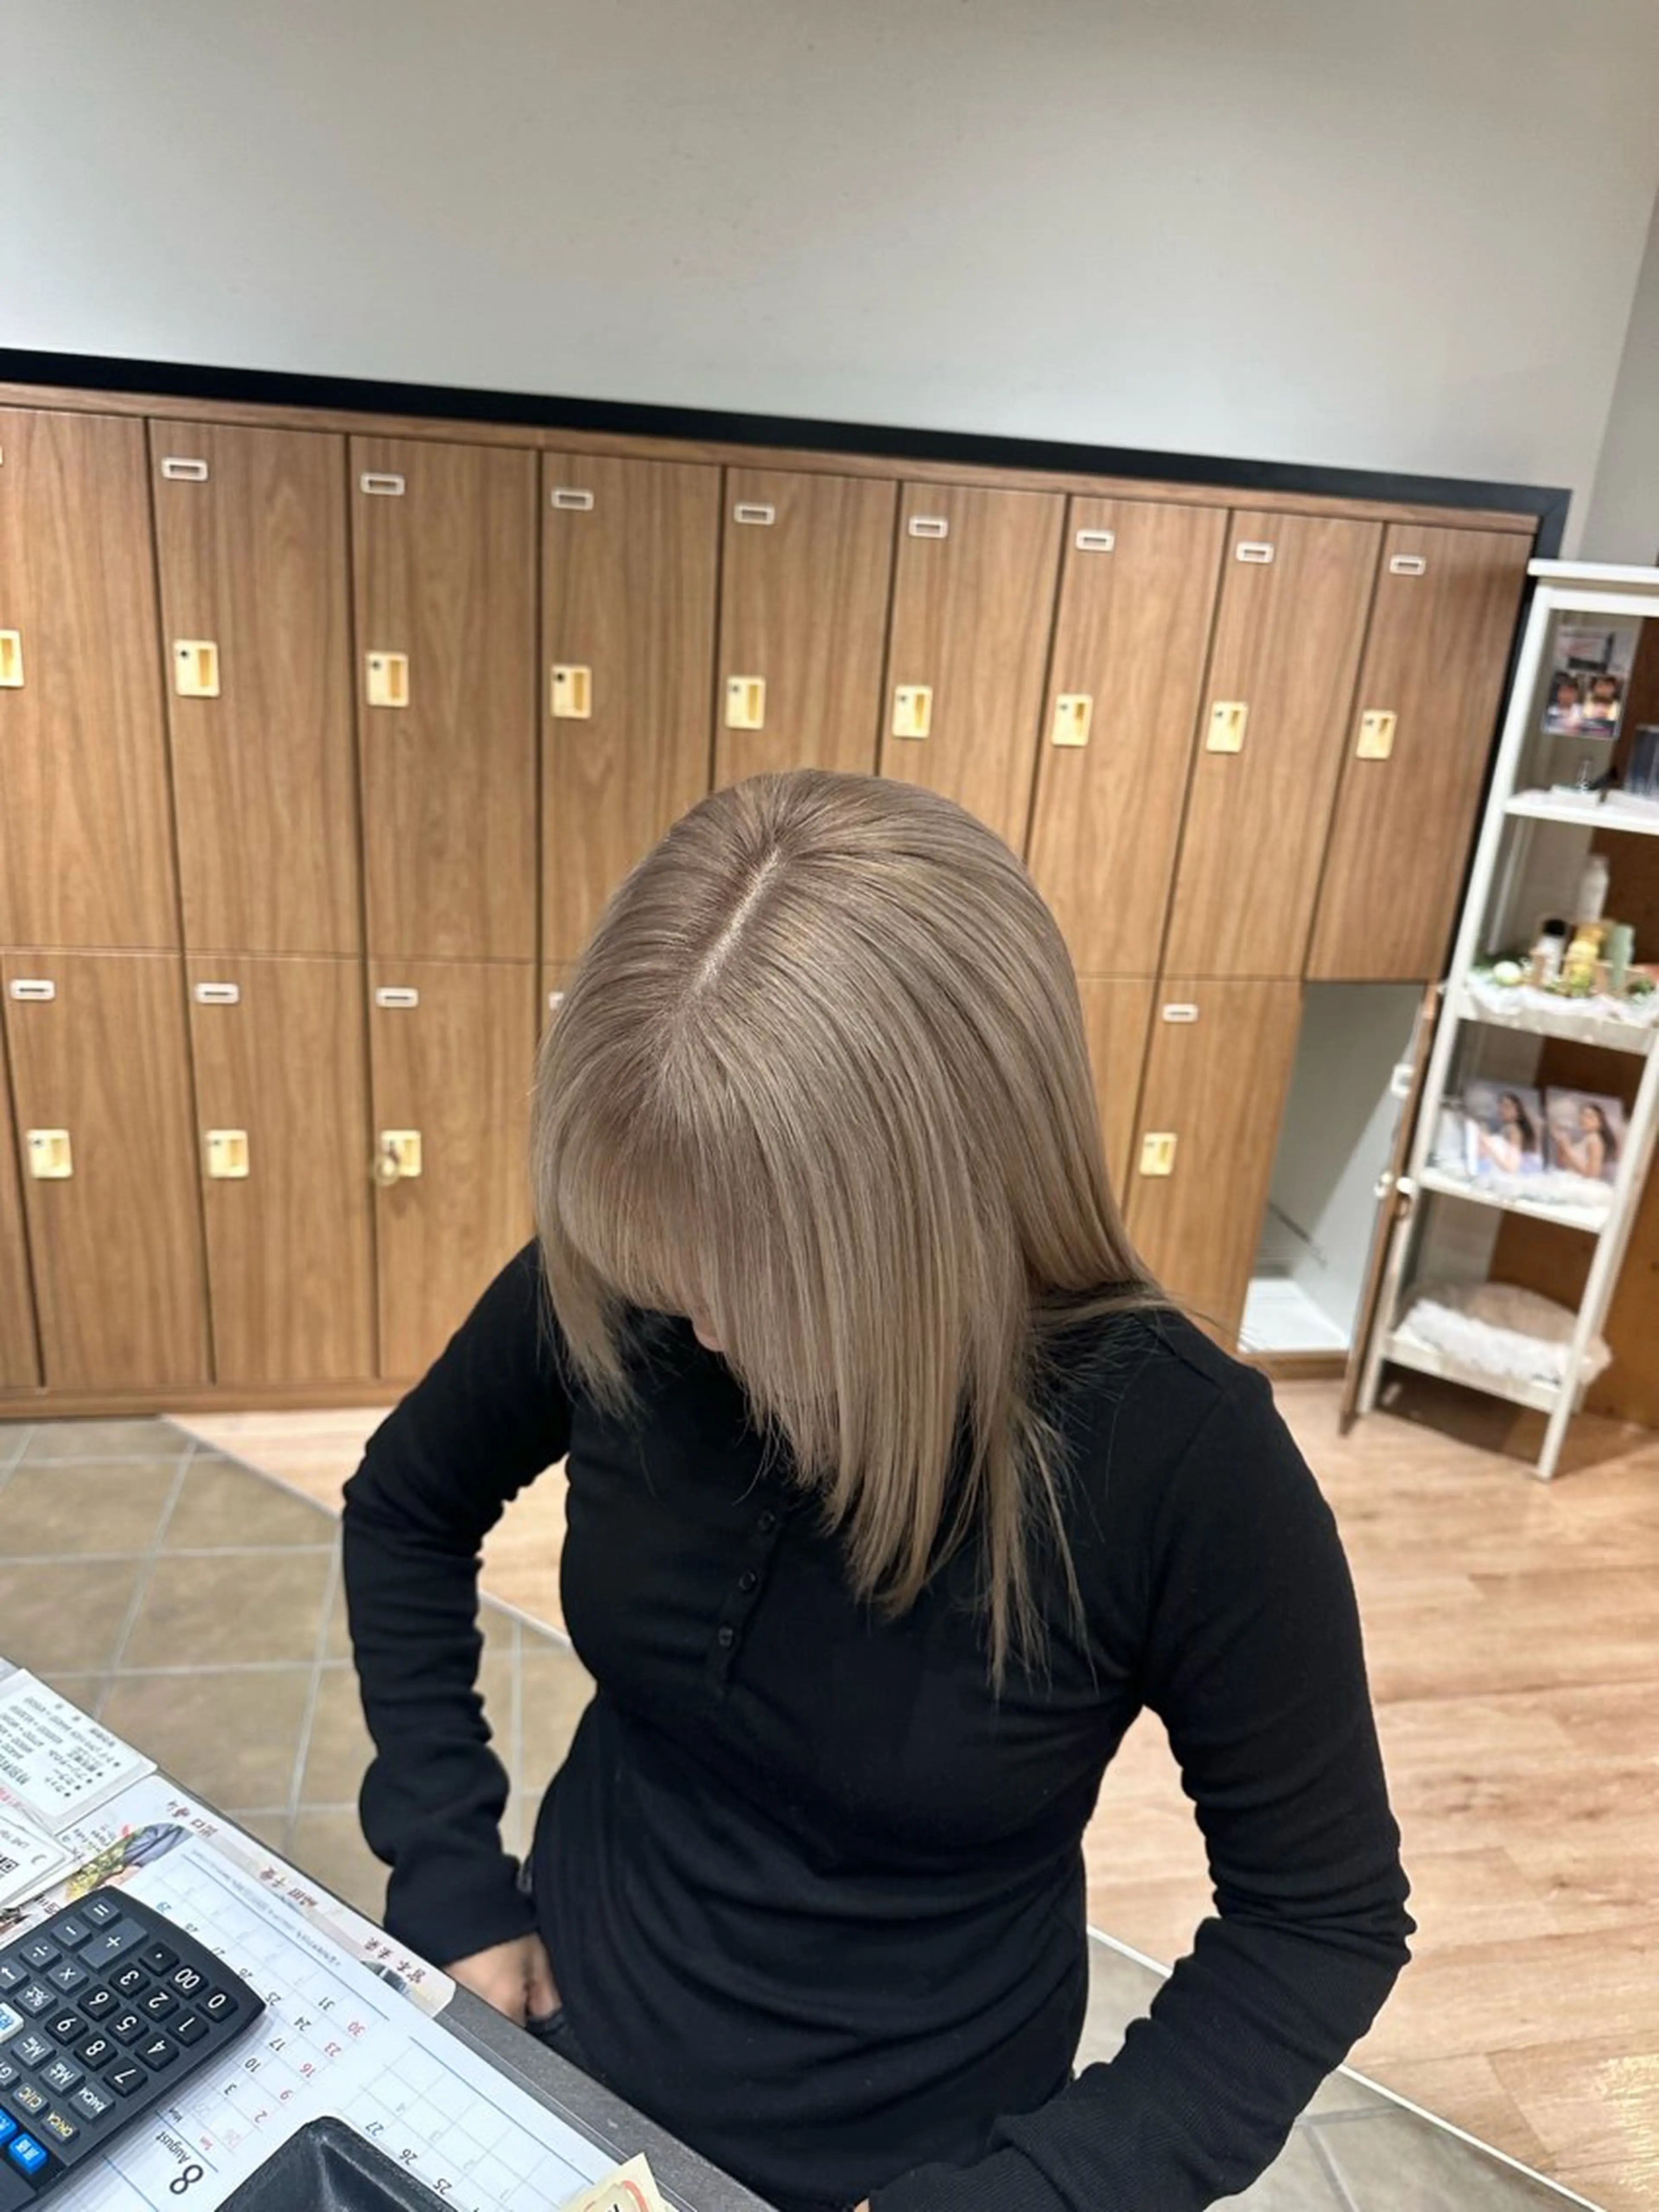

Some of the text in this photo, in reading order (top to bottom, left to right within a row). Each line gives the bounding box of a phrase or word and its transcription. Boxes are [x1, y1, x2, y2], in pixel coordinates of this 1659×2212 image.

[120, 1970, 139, 1985] 3
[175, 1967, 200, 1990] 00
[89, 1991, 109, 2005] 6
[148, 1991, 169, 2009] 2
[207, 1993, 227, 2009] 0
[265, 1992, 282, 2006] 25
[57, 2017, 77, 2031] 9
[116, 2016, 137, 2031] 5
[178, 2017, 195, 2031] 1
[294, 2017, 311, 2031] 24
[318, 1997, 365, 2036] 30 31
[86, 2040, 106, 2056] 8
[147, 2040, 166, 2054] 4
[324, 2042, 341, 2056] 23
[269, 2038, 316, 2078] 16 17
[114, 2069, 136, 2084] 7
[245, 2057, 293, 2100] 9 10
[224, 2083, 267, 2123] 2 3
[156, 2132, 204, 2195] 8 August
[365, 2121, 452, 2195] 25 26 27
